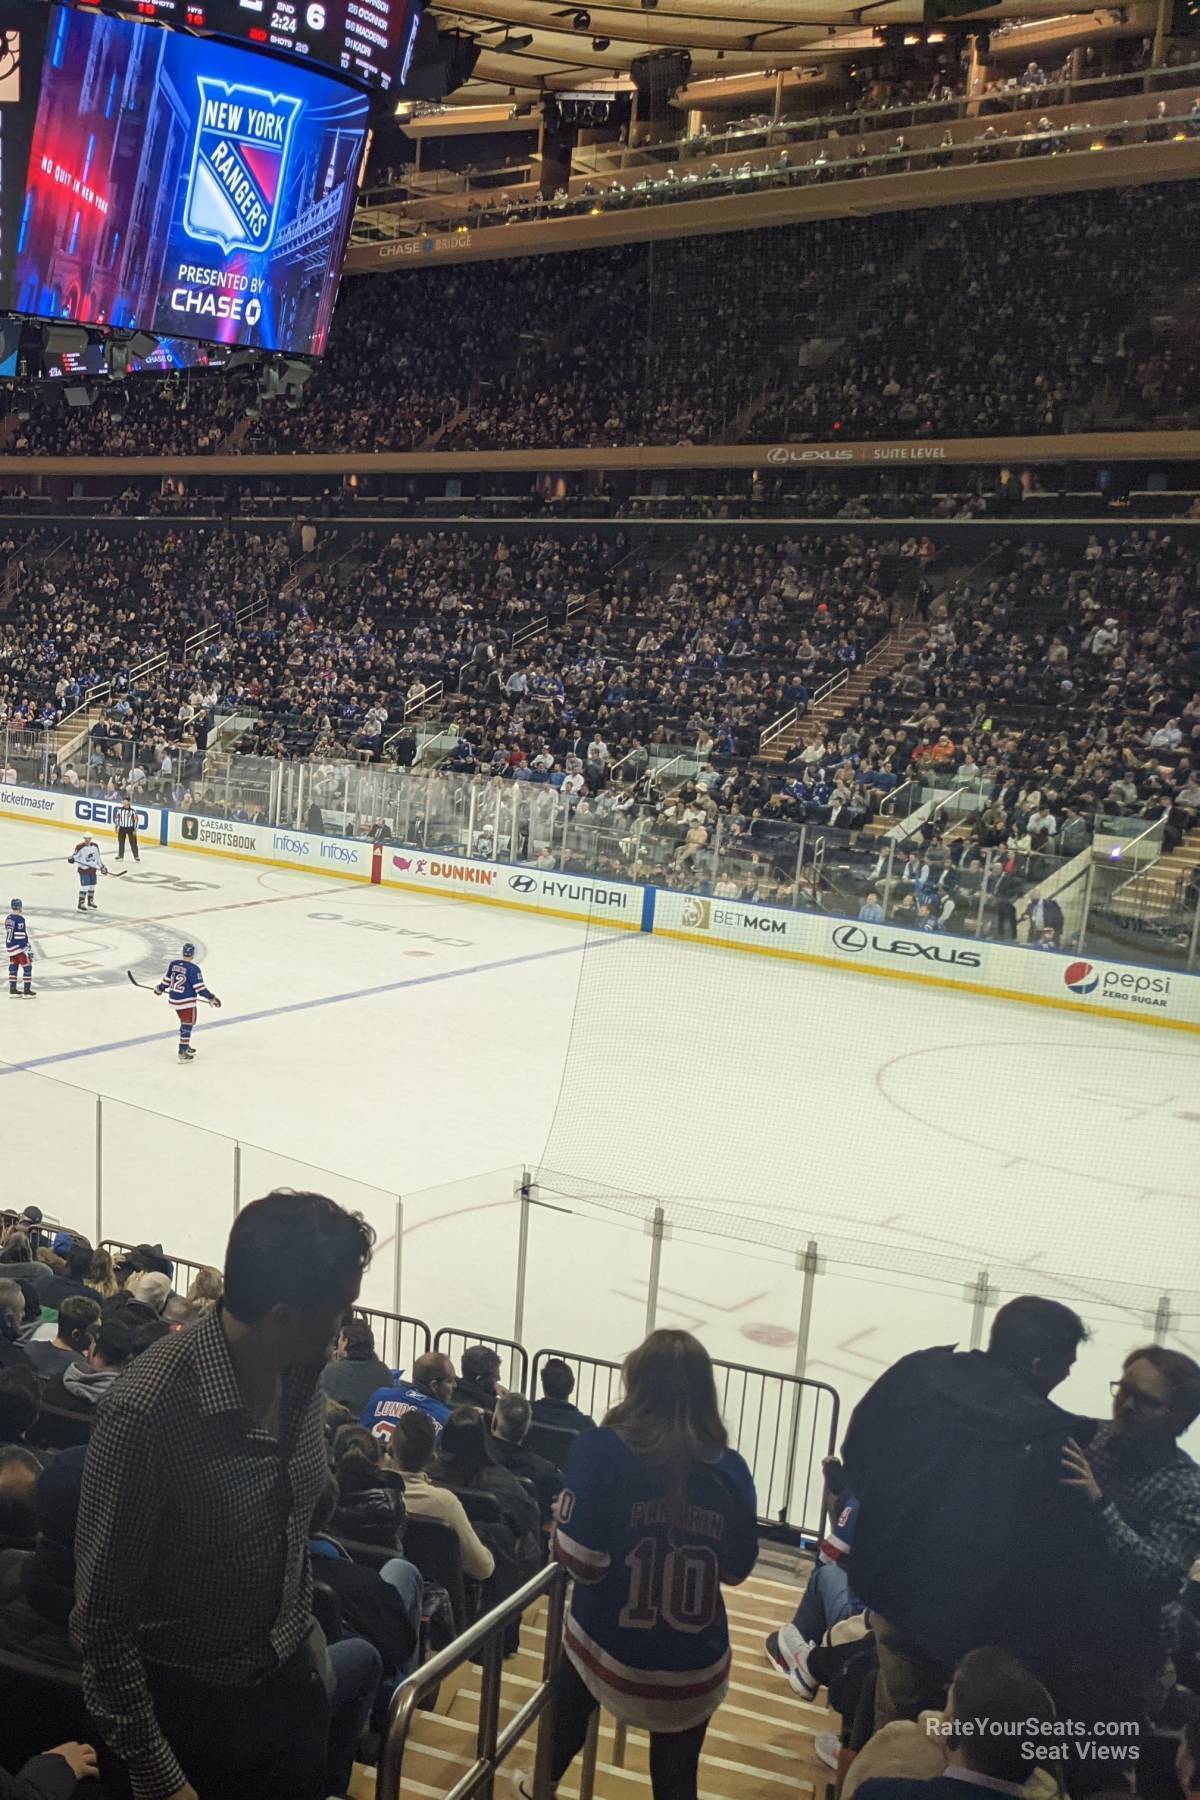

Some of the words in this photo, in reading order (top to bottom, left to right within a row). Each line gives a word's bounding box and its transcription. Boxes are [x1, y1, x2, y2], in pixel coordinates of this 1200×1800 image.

[276, 2, 295, 14] 2ND
[306, 3, 325, 30] 6
[270, 12, 297, 33] 2:24
[204, 98, 244, 133] NEW
[247, 108, 287, 143] YORK
[41, 155, 53, 175] NO
[54, 165, 71, 187] QUIT
[210, 140, 269, 239] RANGERS
[379, 241, 420, 257] CHASE
[435, 235, 472, 250] BRIDGE
[178, 264, 248, 291] PRESENTED
[250, 277, 265, 294] BY
[171, 288, 244, 320] CHASE
[791, 450, 853, 460] LEXUS
[873, 448, 907, 459] SUITE
[910, 448, 946, 459] LEVEL
[0, 790, 55, 810] ticketmaster
[75, 800, 149, 830] GEIO
[200, 819, 233, 831] CAESARS
[200, 830, 257, 851] SPORTSBOOK
[273, 834, 309, 855] Infosys
[320, 842, 358, 864] Infosys
[430, 862, 497, 886] DUNKIN'
[543, 880, 627, 908] HYUNDAI
[713, 910, 786, 934] BETMGM
[871, 937, 981, 968] LEXUS
[1103, 971, 1171, 994] pepsi
[1102, 990, 1129, 1001] ZERO
[1131, 995, 1167, 1007] SUGAR
[619, 1537, 719, 1634] 10
